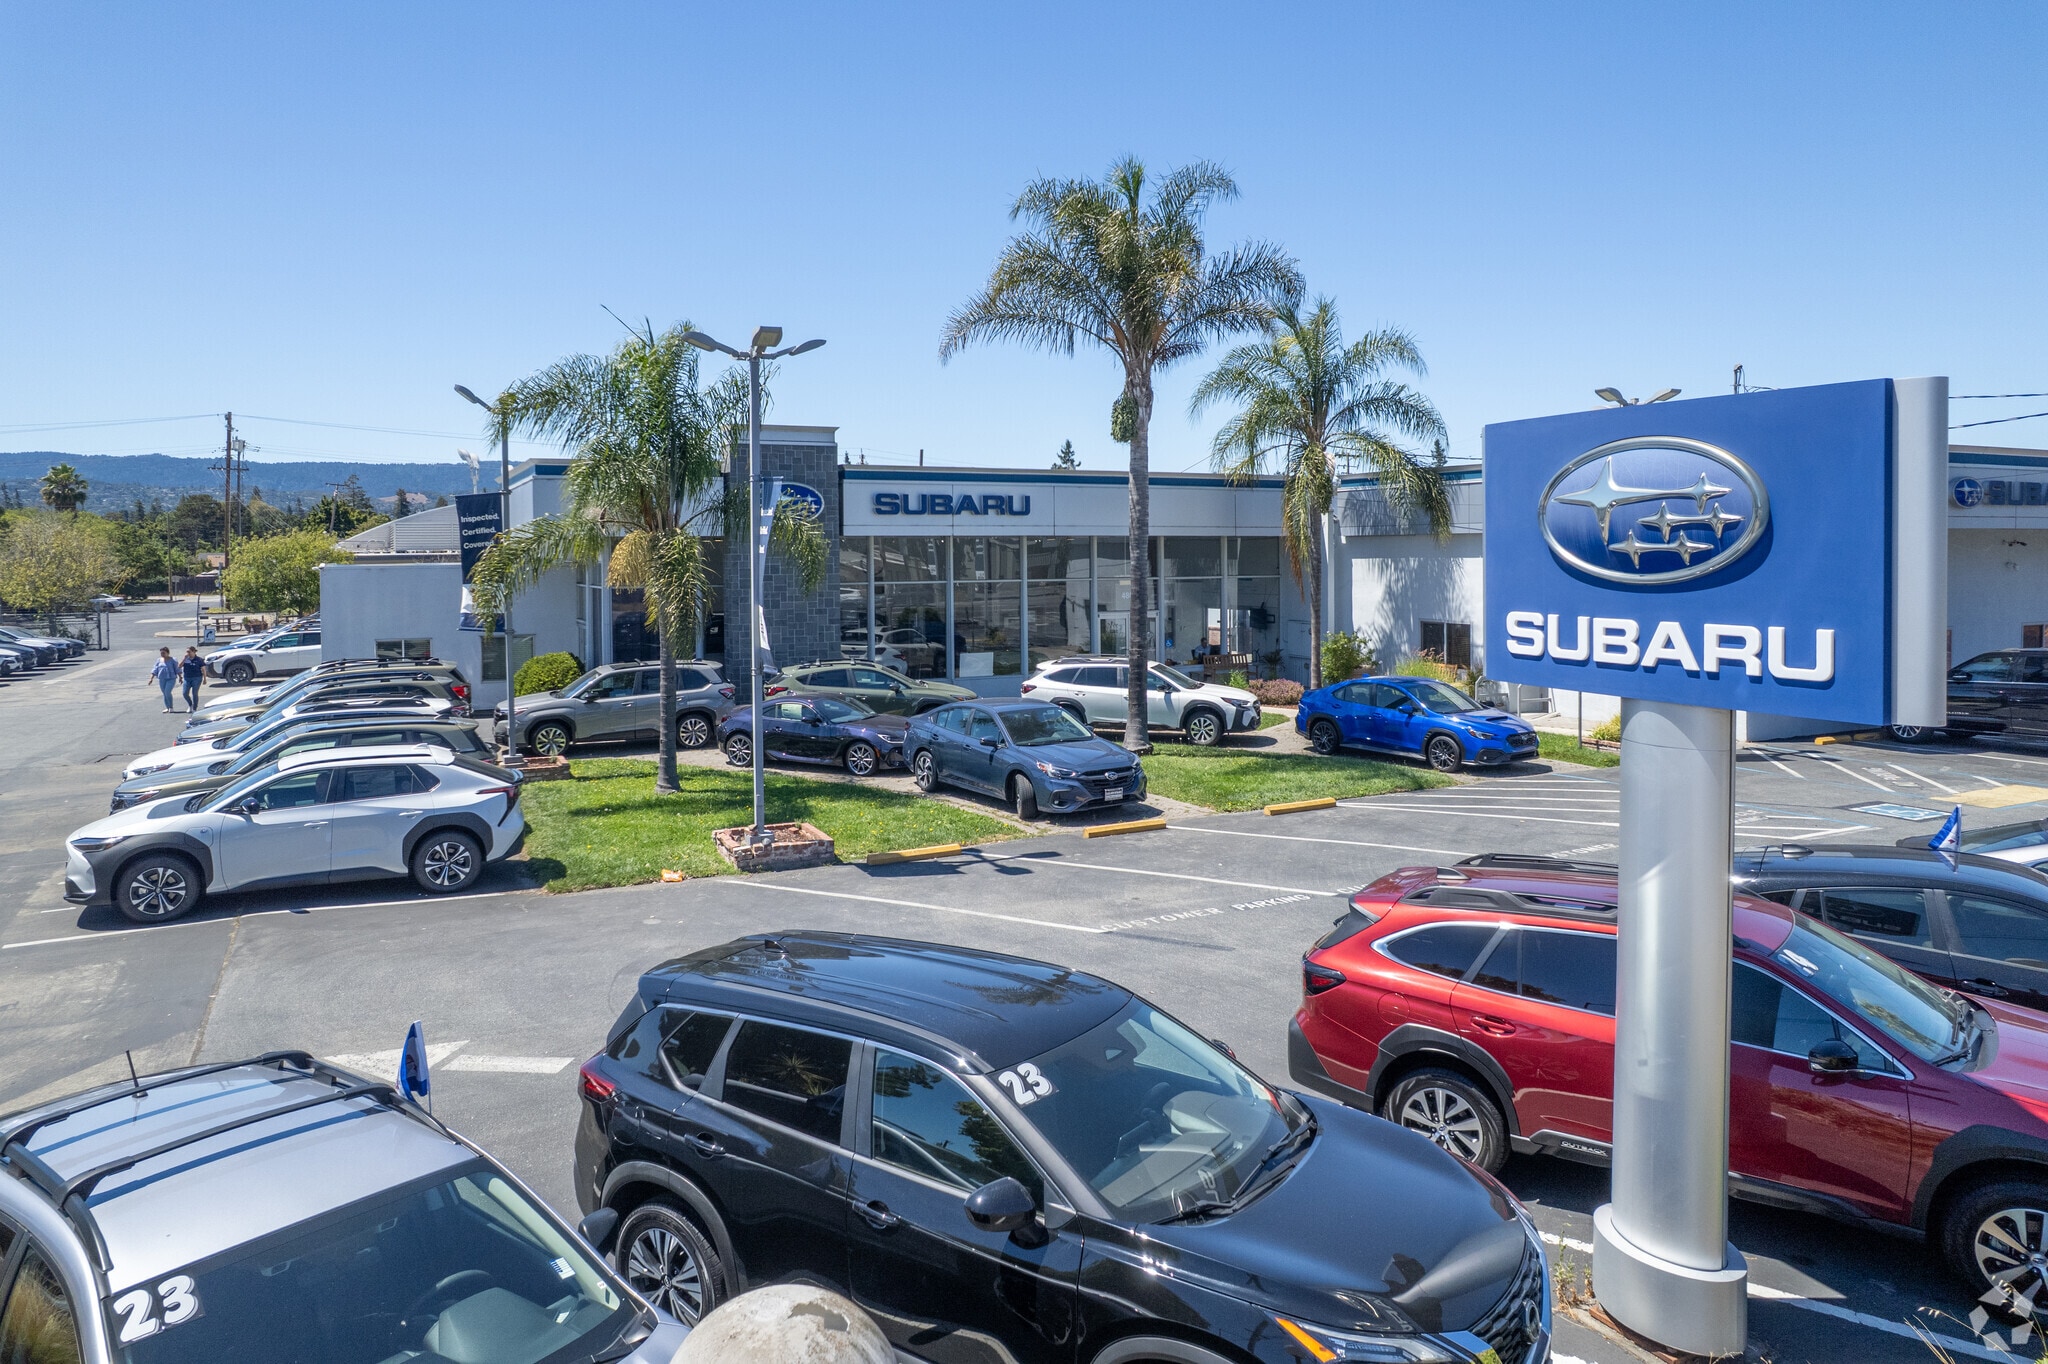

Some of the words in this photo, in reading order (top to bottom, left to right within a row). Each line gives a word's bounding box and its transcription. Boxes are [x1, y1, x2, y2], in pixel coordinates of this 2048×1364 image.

[875, 493, 1031, 516] SUBARU
[1989, 480, 2048, 506] SUB
[460, 513, 500, 523] Inspected.
[462, 526, 497, 536] Certified.
[1506, 611, 1836, 683] SUBARU
[1100, 906, 1225, 933] CUSTOMER
[1230, 894, 1312, 911] PARKING
[998, 1062, 1053, 1105] 23
[1561, 1141, 1608, 1157] OUTBACK
[113, 1275, 199, 1342] 23
